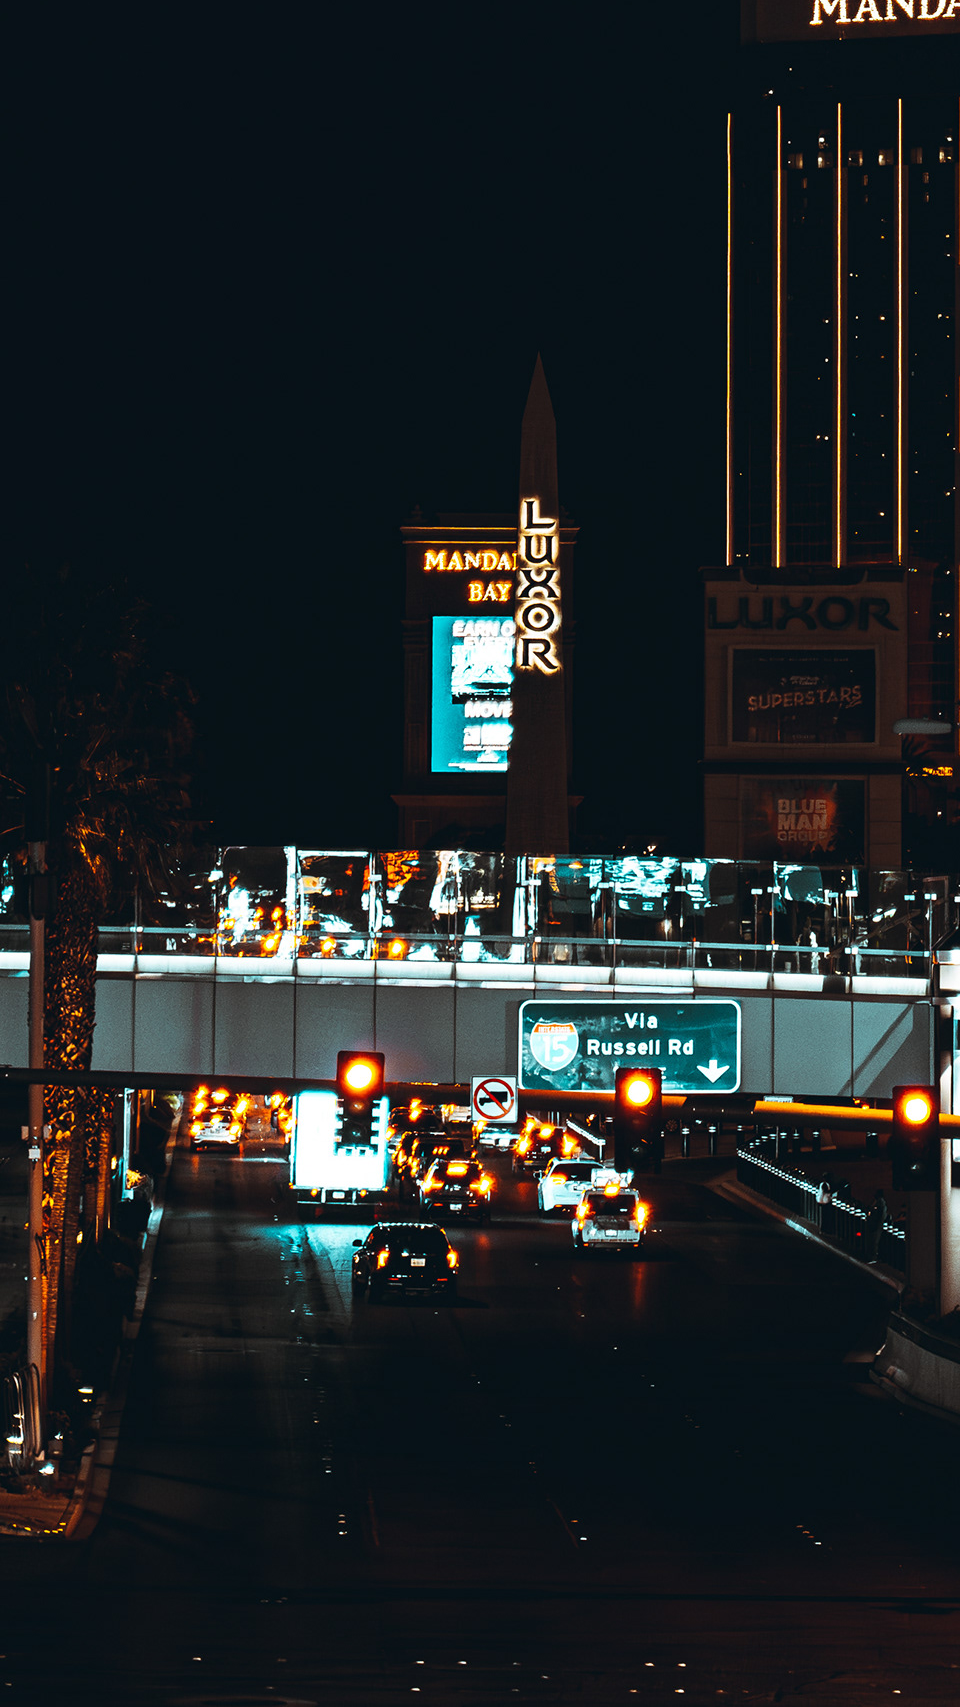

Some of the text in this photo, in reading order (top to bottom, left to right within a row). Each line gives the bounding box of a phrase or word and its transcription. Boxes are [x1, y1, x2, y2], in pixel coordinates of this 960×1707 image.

[467, 581, 513, 603] BAY
[518, 499, 560, 671] LUXOR
[707, 596, 899, 631] LUXOR
[453, 620, 500, 637] EARN
[748, 685, 864, 712] SUPERSTARS
[777, 799, 827, 814] BLUE
[777, 814, 827, 830] MAN
[777, 830, 828, 842] GROUP
[624, 1012, 658, 1029] Via
[542, 1035, 569, 1063] 15
[587, 1038, 694, 1056] Russell Rd
